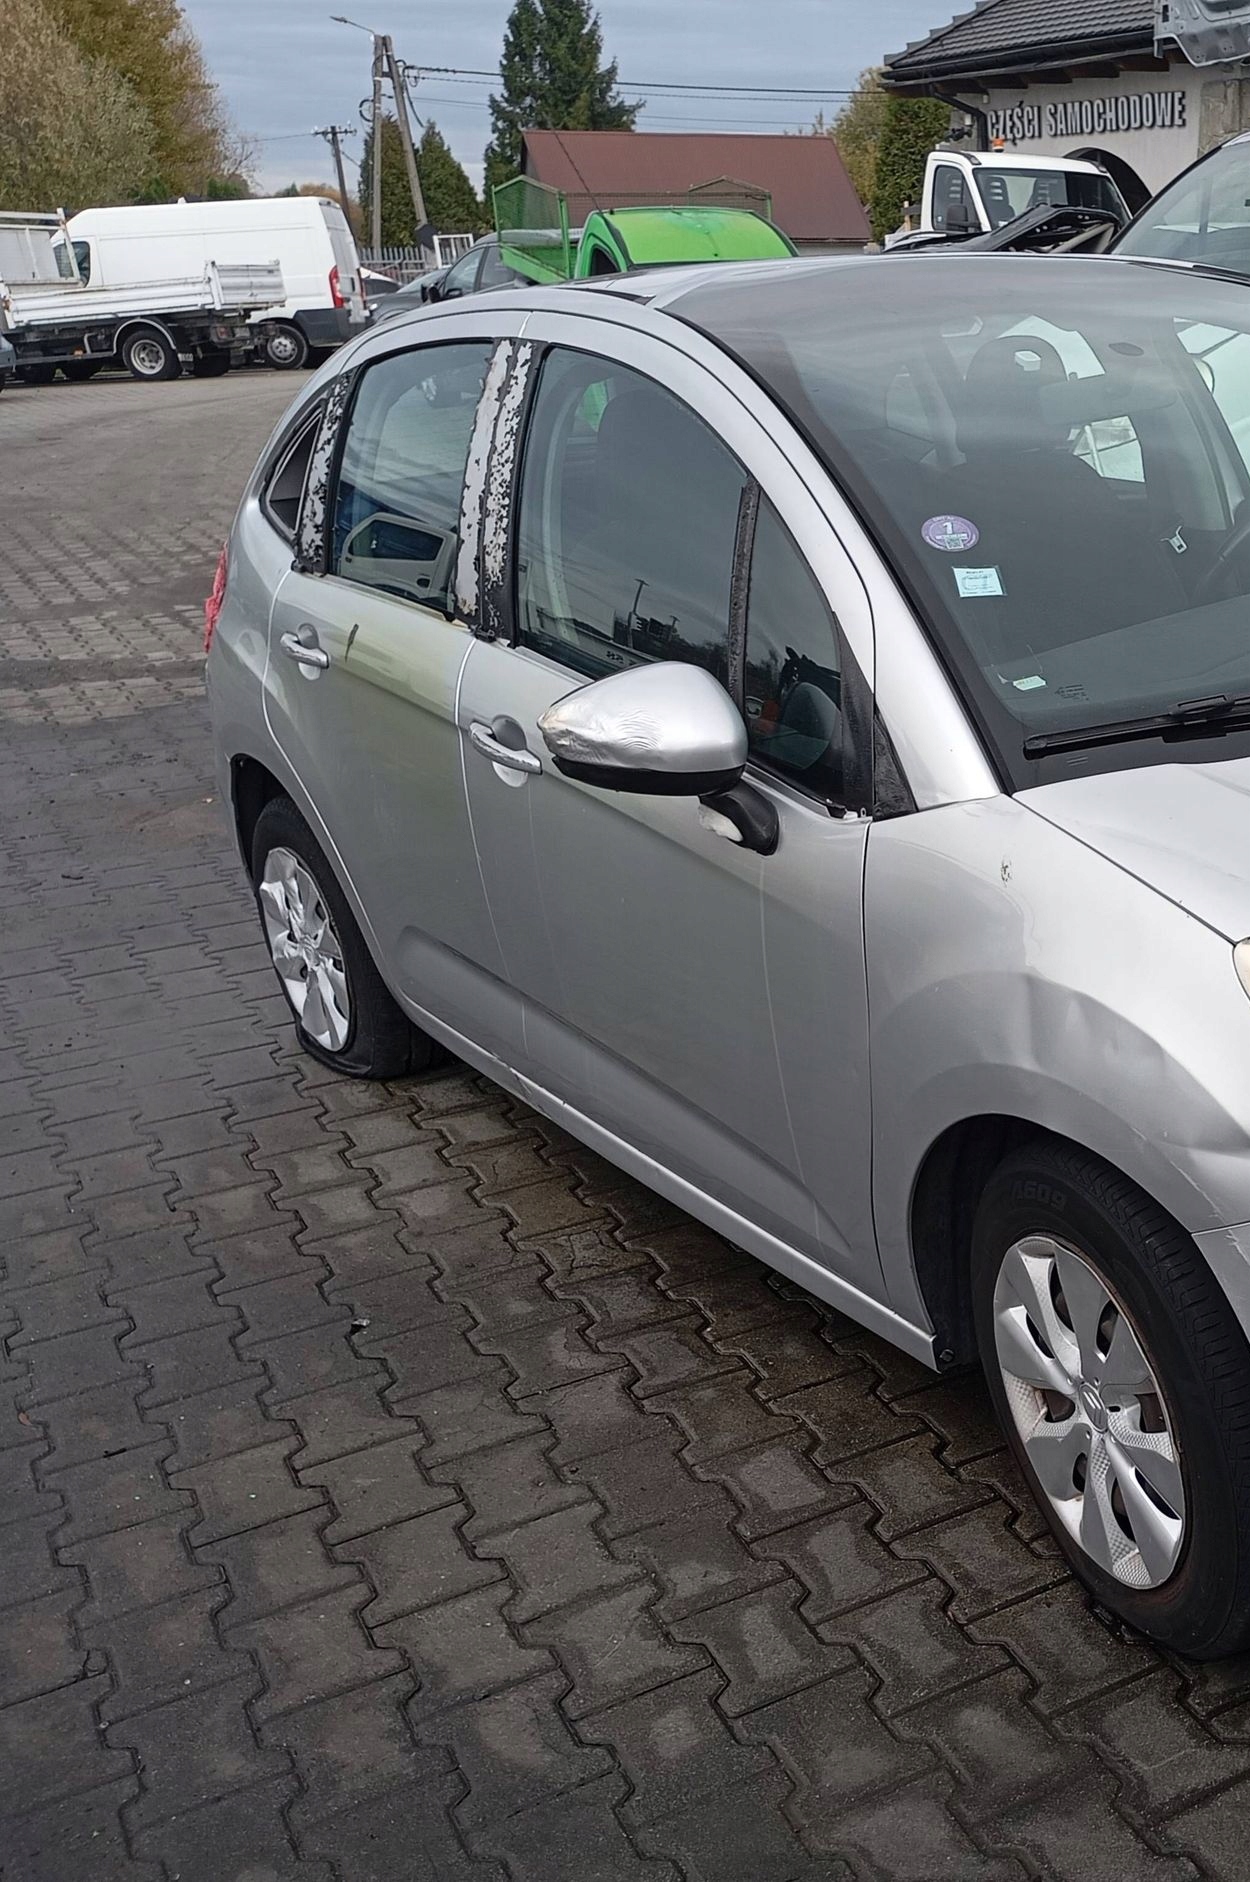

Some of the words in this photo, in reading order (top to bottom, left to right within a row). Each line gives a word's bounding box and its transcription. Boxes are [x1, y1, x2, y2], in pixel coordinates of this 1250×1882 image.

[987, 100, 1041, 146] CZĘŚCI
[1047, 91, 1186, 136] SAMOCHODOWE
[942, 522, 953, 534] 1
